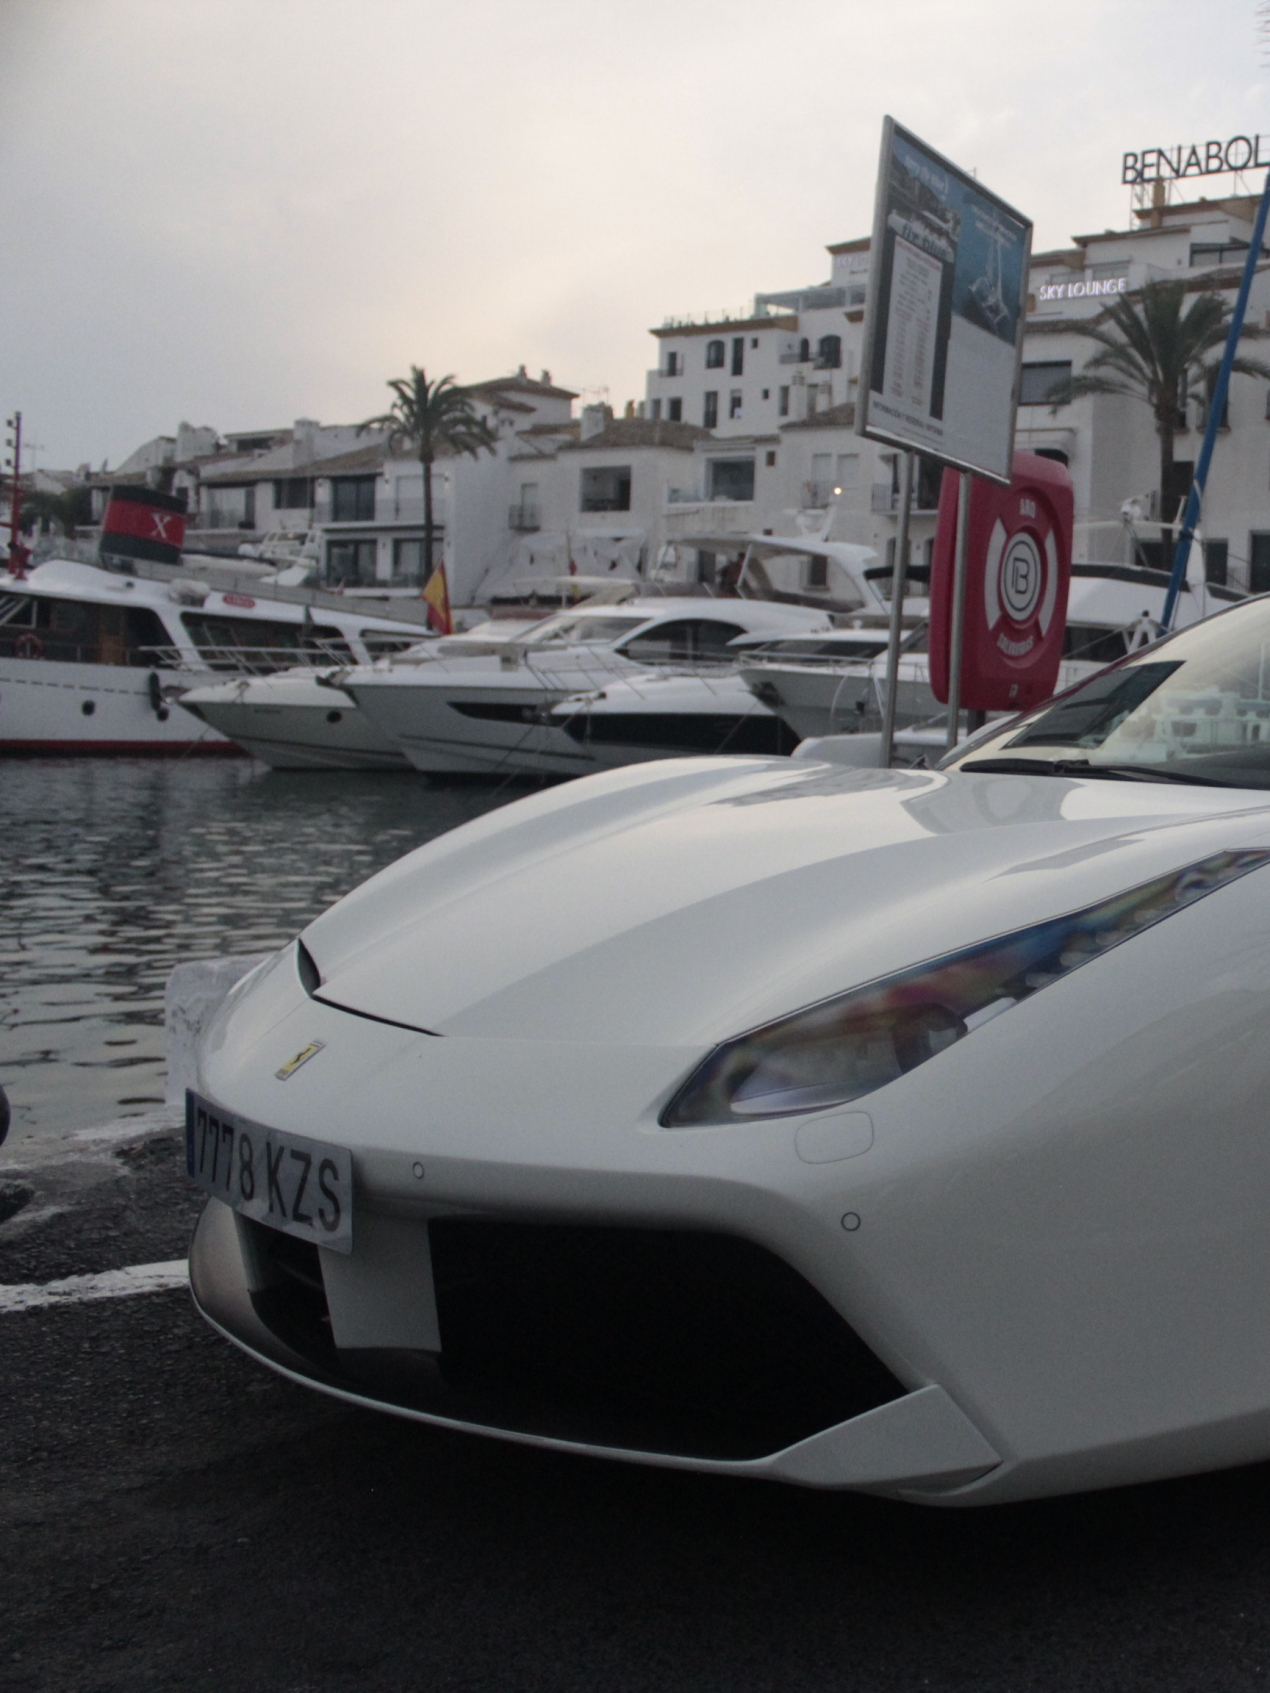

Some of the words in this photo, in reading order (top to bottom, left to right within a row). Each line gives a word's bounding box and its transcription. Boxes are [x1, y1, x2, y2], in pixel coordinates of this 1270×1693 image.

[1039, 284, 1066, 300] SKY
[1068, 277, 1127, 298] LOUNGE
[1019, 498, 1037, 518] ARO
[150, 512, 171, 539] X
[197, 1107, 256, 1201] 7778
[266, 1140, 341, 1233] KZS
